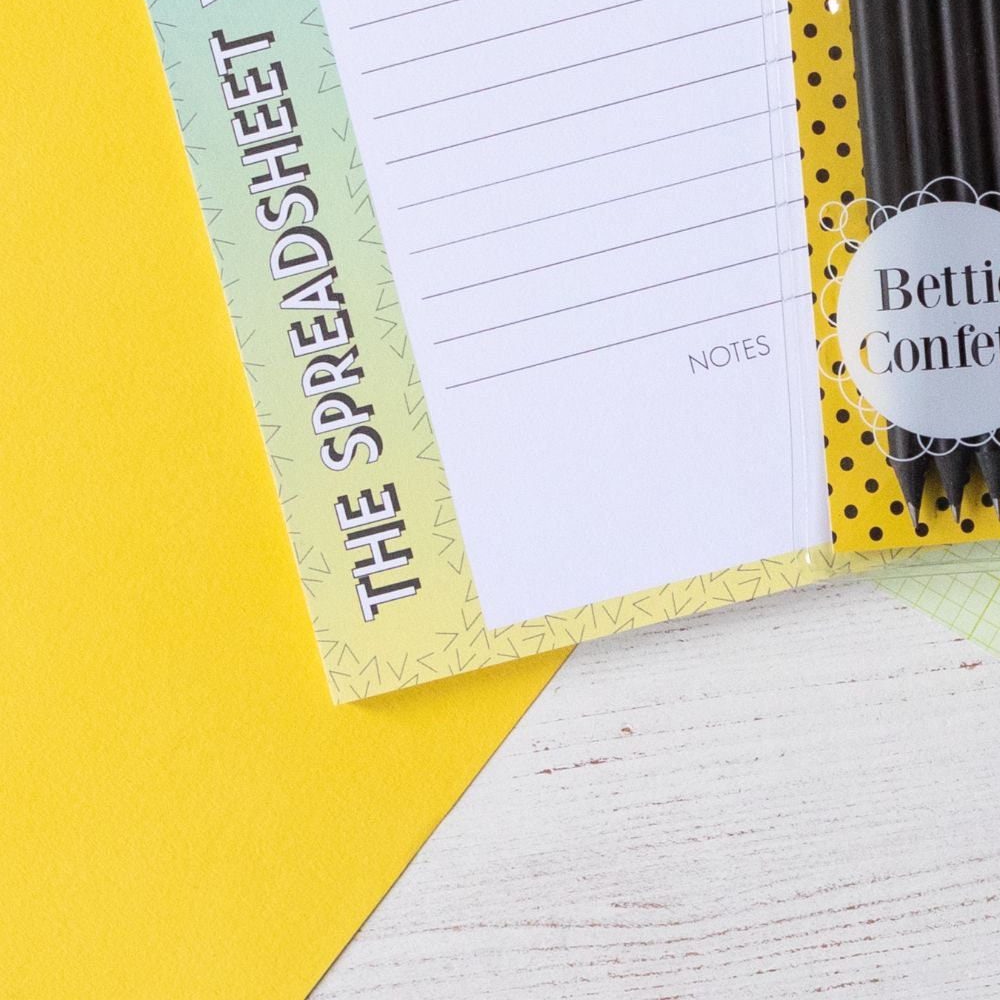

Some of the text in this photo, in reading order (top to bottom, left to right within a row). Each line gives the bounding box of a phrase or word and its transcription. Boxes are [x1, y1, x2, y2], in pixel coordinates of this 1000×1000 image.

[209, 29, 384, 472] SPREADSHEET
[687, 334, 772, 375] NOTES
[334, 482, 421, 623] THE
